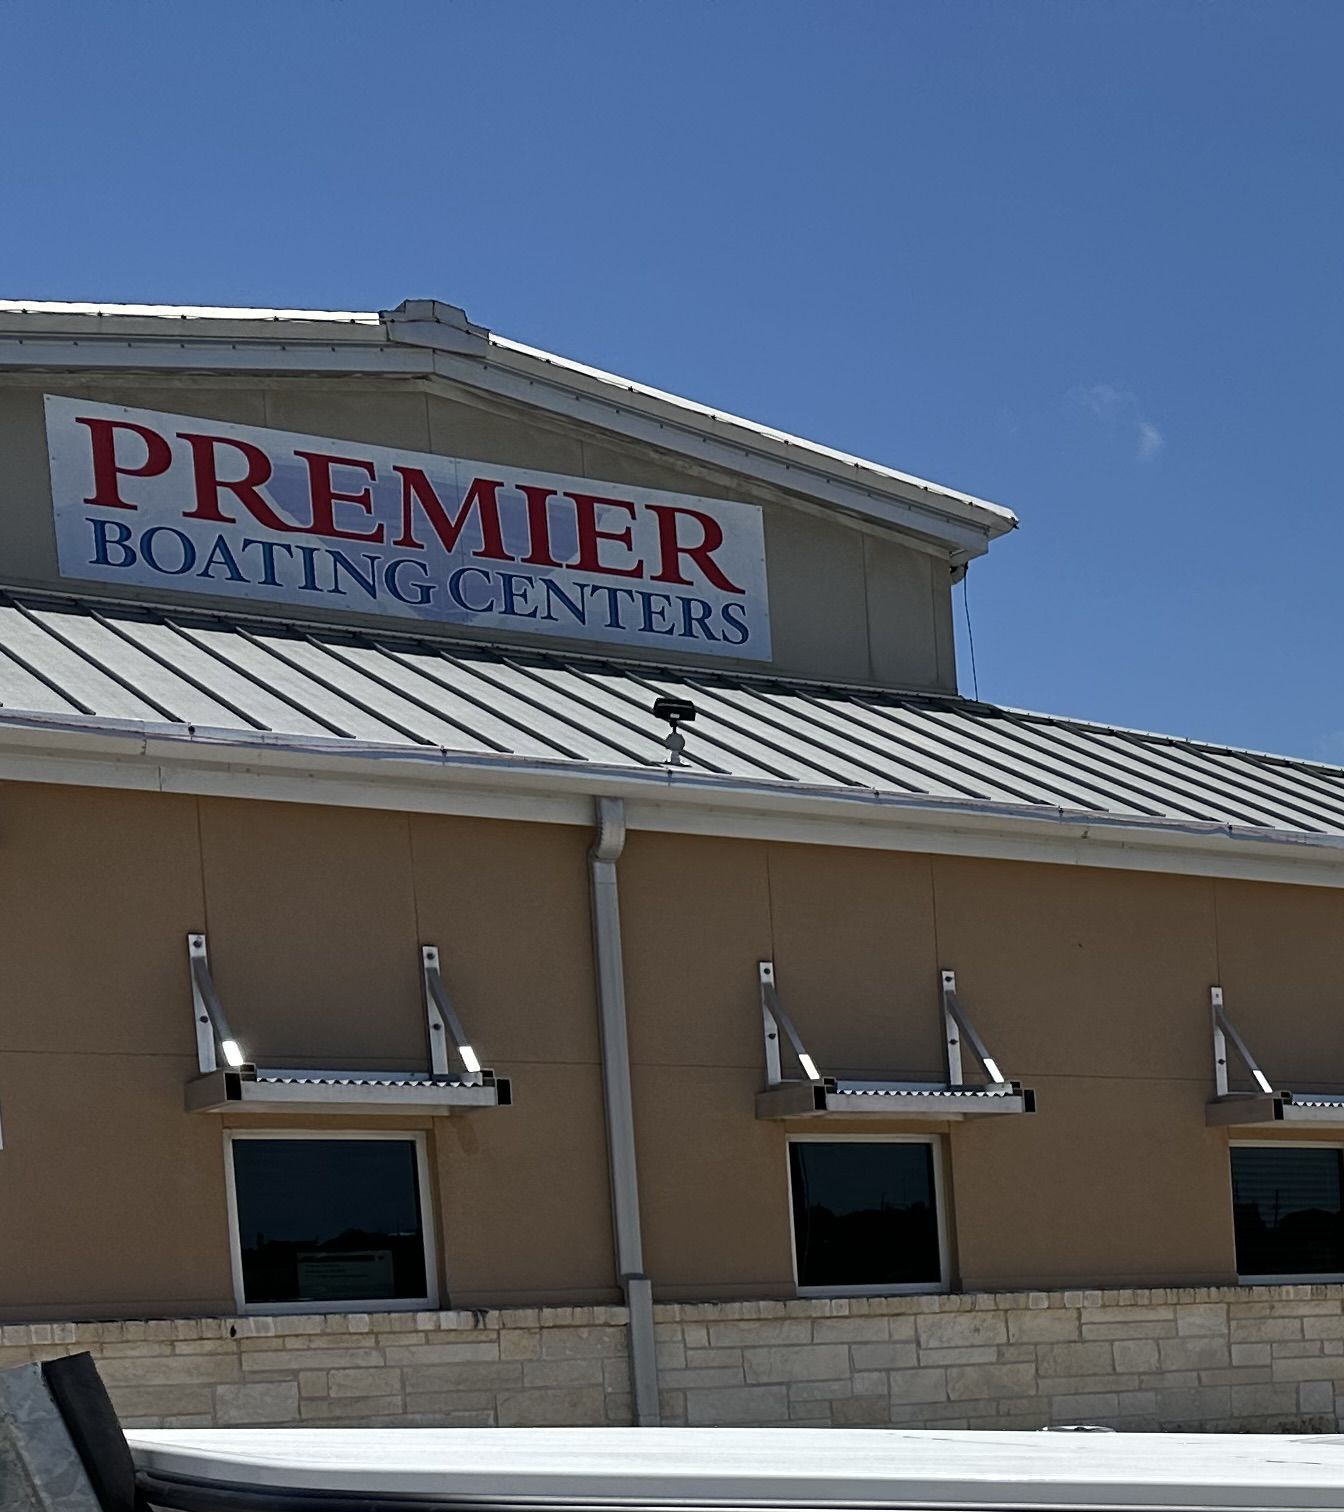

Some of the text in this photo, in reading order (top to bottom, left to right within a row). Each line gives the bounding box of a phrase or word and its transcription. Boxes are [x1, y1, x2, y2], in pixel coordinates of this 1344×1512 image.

[75, 416, 747, 595] PREMIER
[84, 517, 750, 646] BOATING CENTERS
